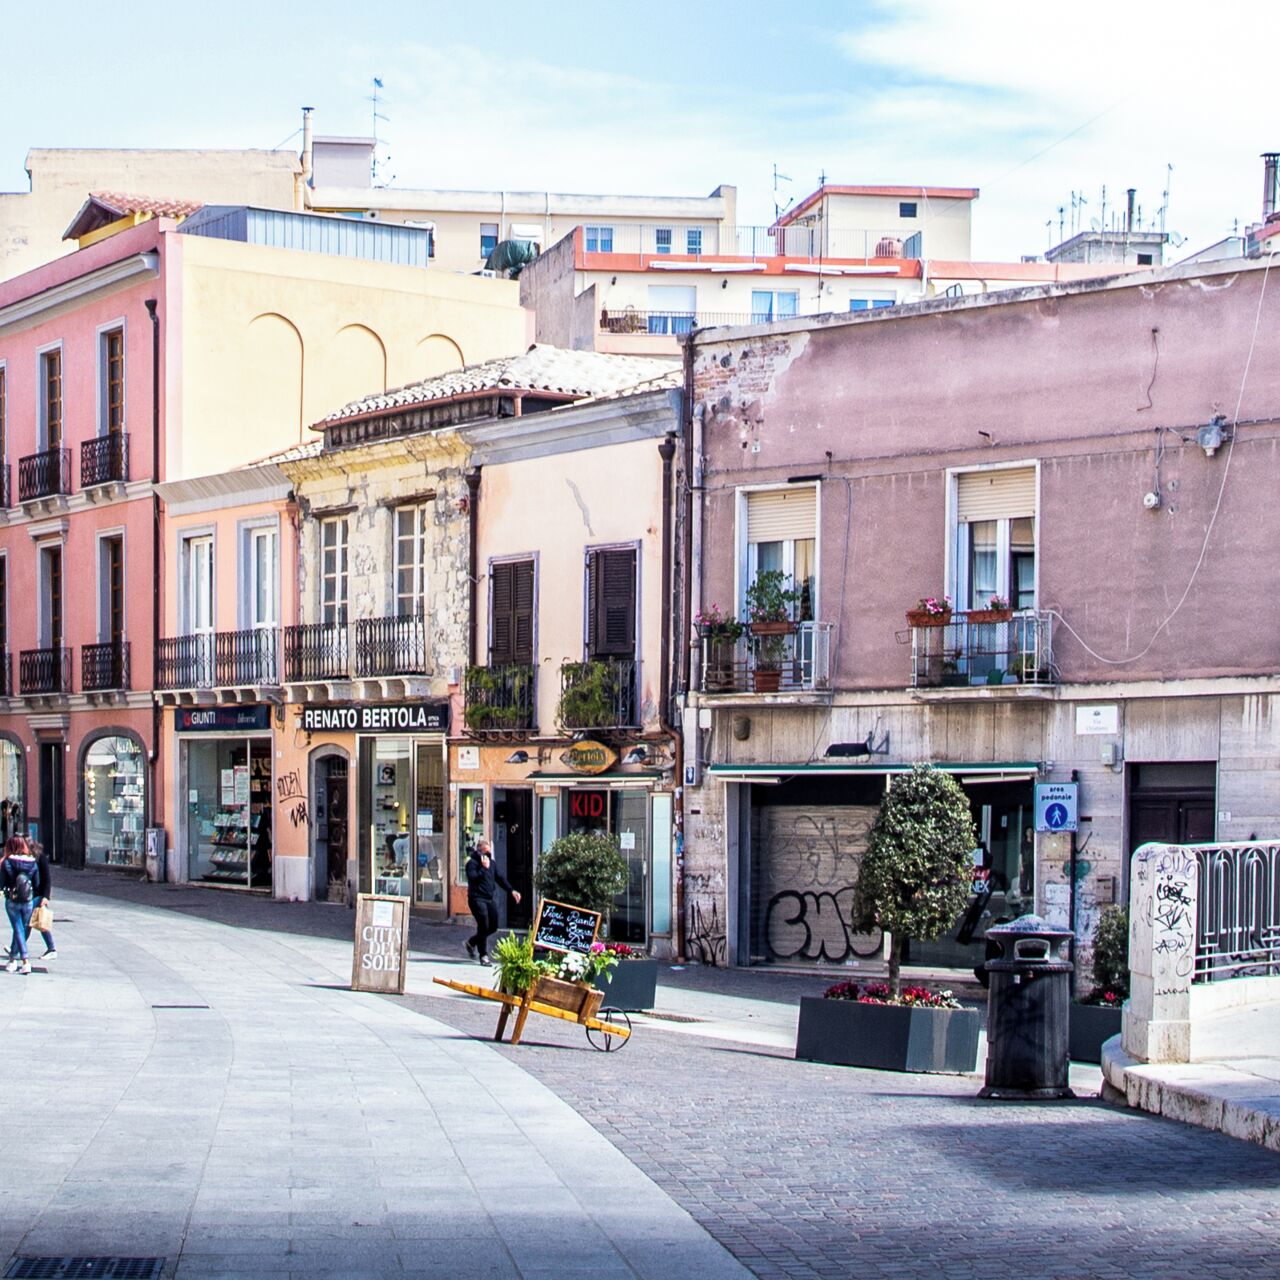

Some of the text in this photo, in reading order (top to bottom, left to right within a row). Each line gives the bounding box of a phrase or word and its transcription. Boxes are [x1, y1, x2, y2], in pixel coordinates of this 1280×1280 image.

[191, 711, 216, 725] GIUNTI
[304, 706, 427, 729] RENATO BERTOLA
[571, 794, 604, 818] KID
[1040, 793, 1073, 802] pedonale
[369, 940, 398, 956] DEL
[361, 954, 401, 972] SOLE
